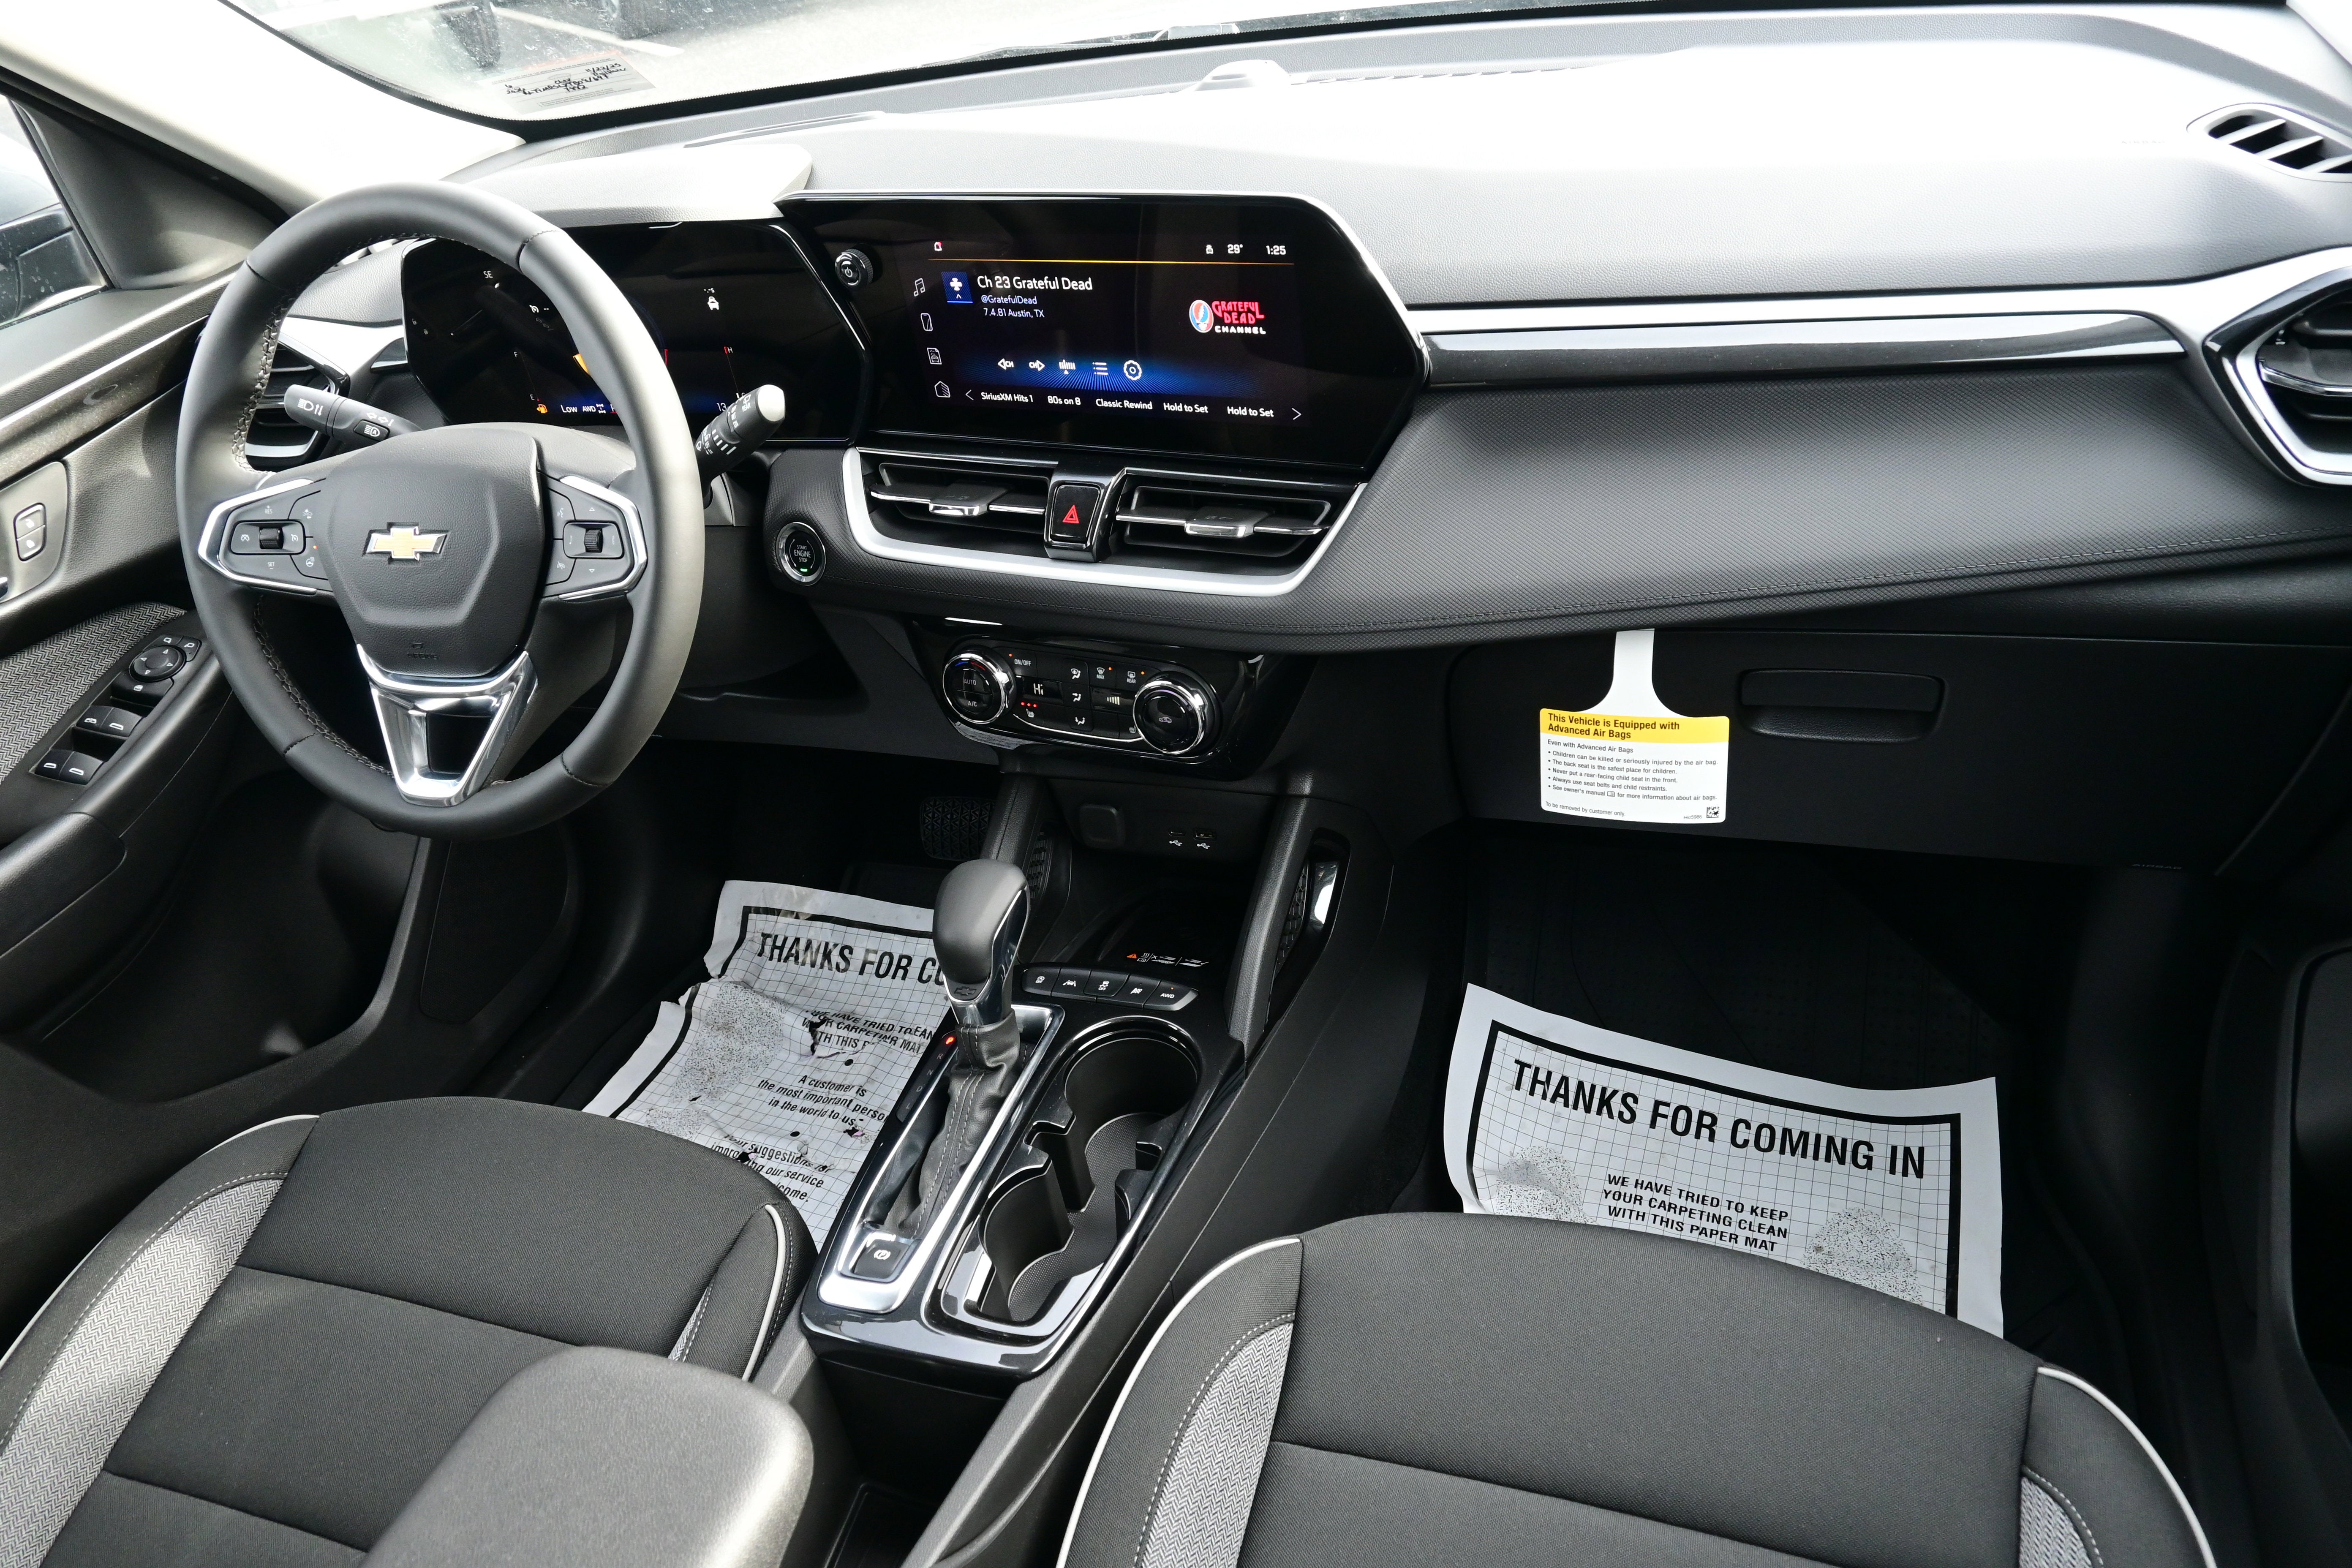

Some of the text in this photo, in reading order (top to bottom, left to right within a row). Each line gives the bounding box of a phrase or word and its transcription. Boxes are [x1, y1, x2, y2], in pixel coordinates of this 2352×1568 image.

[1266, 245, 1286, 255] 1:25
[977, 275, 1092, 290] Ch 23 Grateful Dead
[981, 295, 1037, 304] @GratefulDead
[983, 308, 1044, 318] 7.4.81 Austin, TX
[1211, 300, 1264, 320] GRATEFUL
[1224, 310, 1257, 324] DEAD
[1215, 326, 1266, 334] CHANNEL
[981, 392, 1012, 401] SiriusXM
[1048, 396, 1062, 404] 80s
[561, 405, 577, 413] Low
[1096, 399, 1152, 409] Classic Rewind
[1164, 403, 1182, 411] Hold
[1195, 404, 1208, 413] Set
[1228, 406, 1247, 415] Hold
[1259, 408, 1274, 417] Set
[794, 550, 811, 558] ENGINE
[1033, 683, 1044, 695] Hi
[1548, 713, 1565, 722] This
[1569, 716, 1600, 726] Vehicle
[1614, 720, 1656, 730] Equipped
[1549, 722, 1591, 735] Advanced
[1609, 730, 1631, 740] Bags
[757, 931, 853, 974] THANKS
[858, 948, 912, 980] FOR
[831, 1013, 861, 1023] HAVE
[863, 1020, 895, 1032] TRIED
[836, 1035, 859, 1048] THIS
[945, 1036, 955, 1045] P
[798, 1075, 867, 1097] A customer is
[758, 1079, 775, 1090] the
[776, 1085, 803, 1098] most
[804, 1091, 854, 1108] important
[852, 1103, 889, 1122] perso
[768, 1097, 840, 1119] in the world to
[1515, 1057, 1924, 1179] THANKS FOR COMING IN
[765, 1167, 824, 1188] our service
[1609, 1174, 1788, 1221] WE HAVE TRIED TO KEEP
[1604, 1190, 1787, 1242] YOUR CARPETING CLEAN
[1609, 1206, 1777, 1251] WITH THIS PAPER MAT
